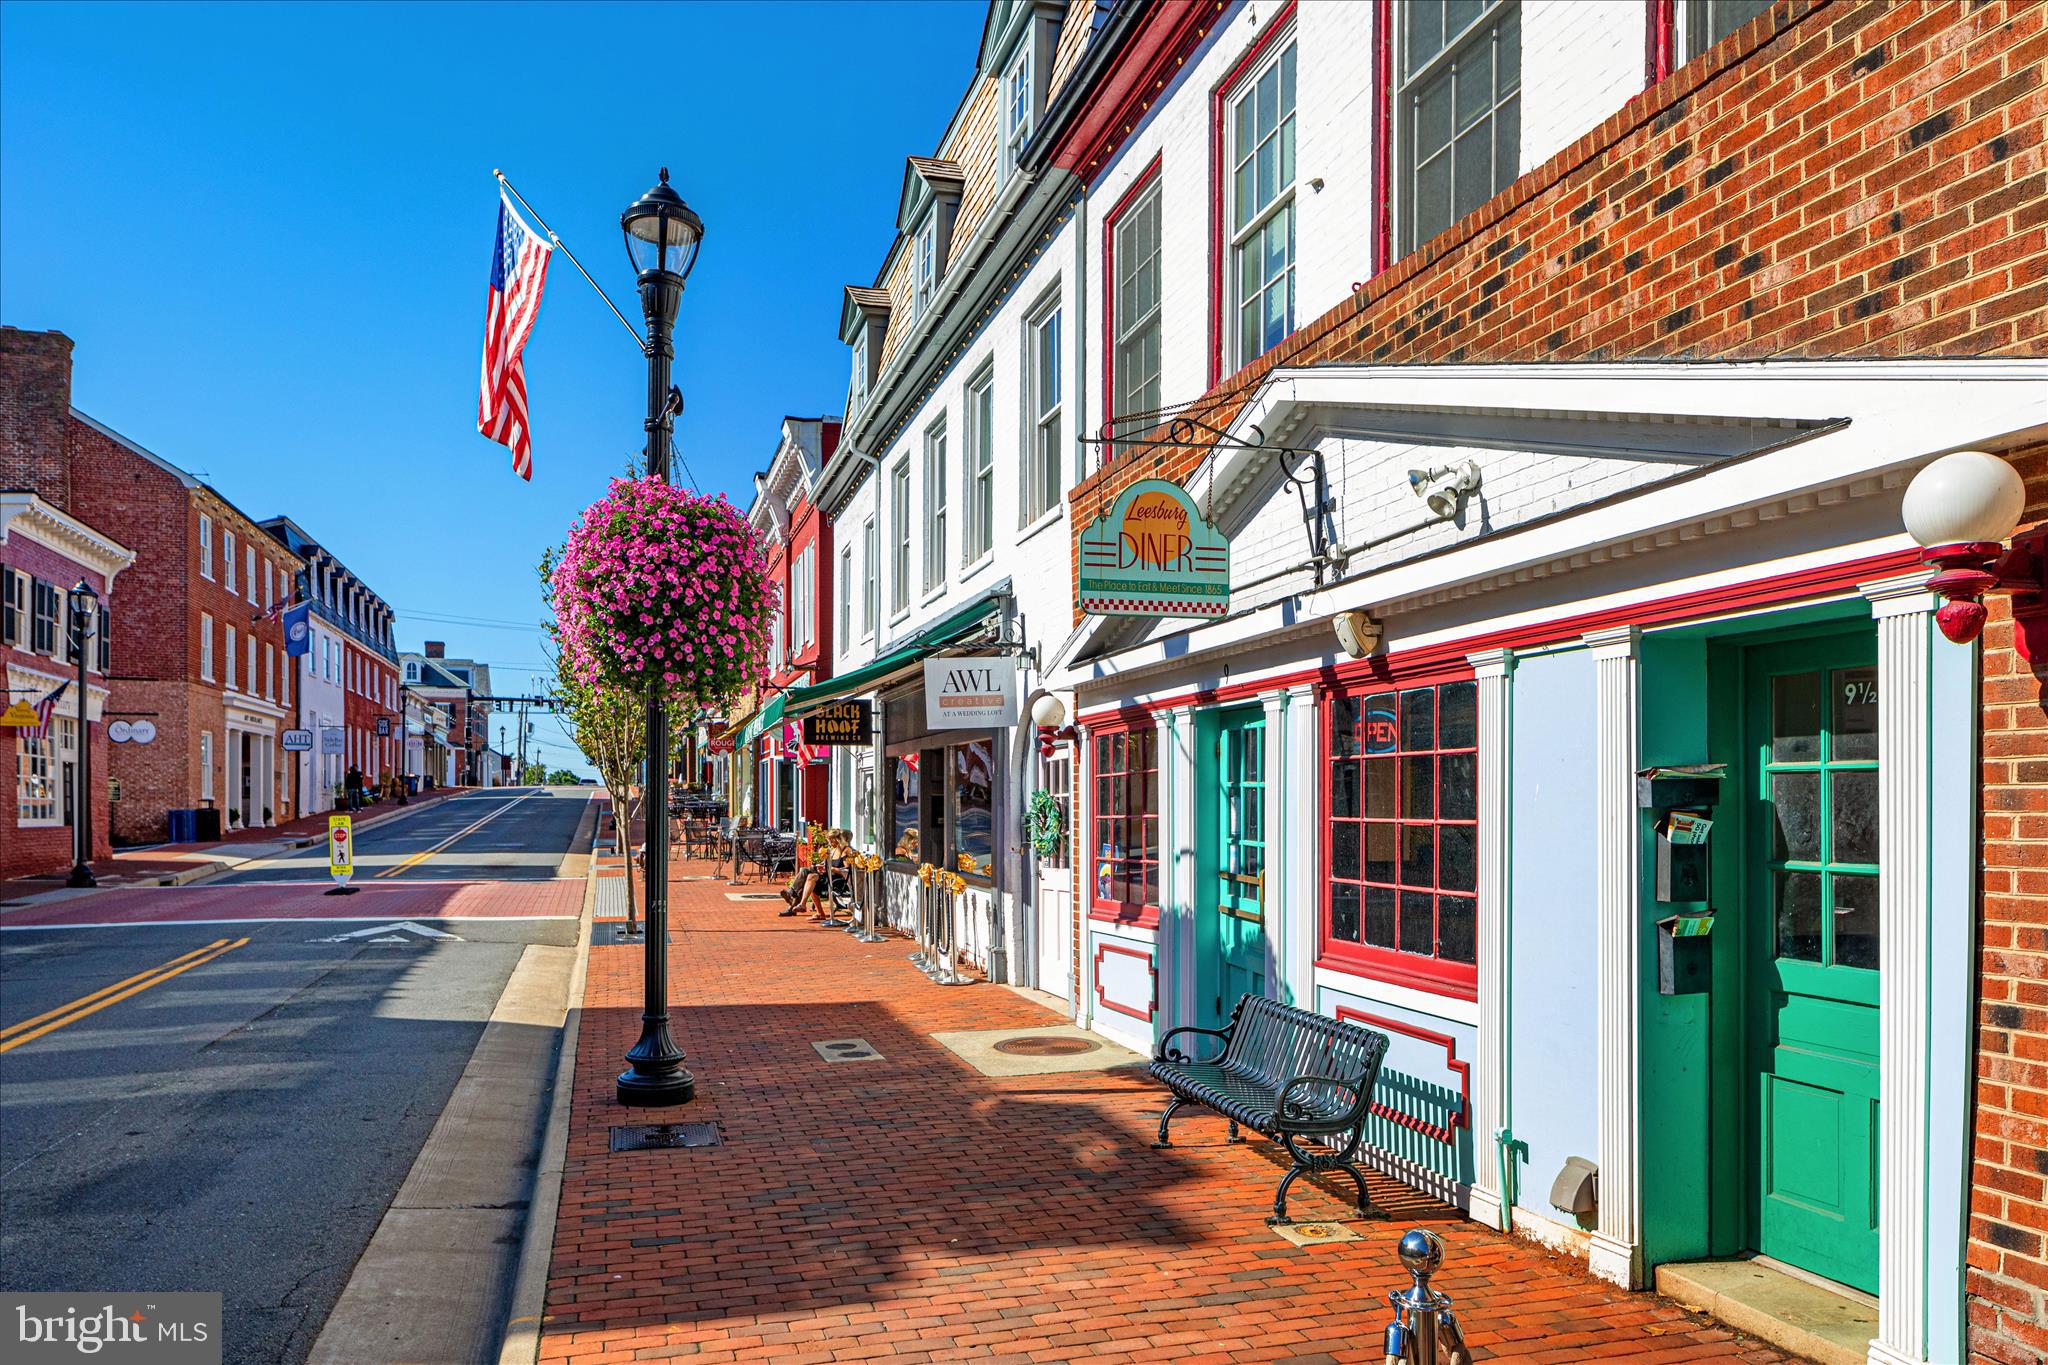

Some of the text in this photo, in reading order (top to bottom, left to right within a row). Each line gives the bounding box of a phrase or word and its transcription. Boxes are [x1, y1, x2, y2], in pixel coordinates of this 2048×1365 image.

[1125, 494, 1188, 530] Leesburg
[1118, 531, 1194, 573] DINER
[1088, 579, 1101, 590] The
[1103, 580, 1127, 591] Place
[1129, 581, 1137, 591] to
[1138, 582, 1151, 591] Eat
[1152, 583, 1159, 592] &
[1160, 583, 1180, 592] Meet
[1182, 584, 1201, 593] Since
[942, 668, 1001, 693] AWL
[942, 697, 1001, 706] creative
[816, 719, 861, 734] HOOF
[286, 734, 310, 744] AHT
